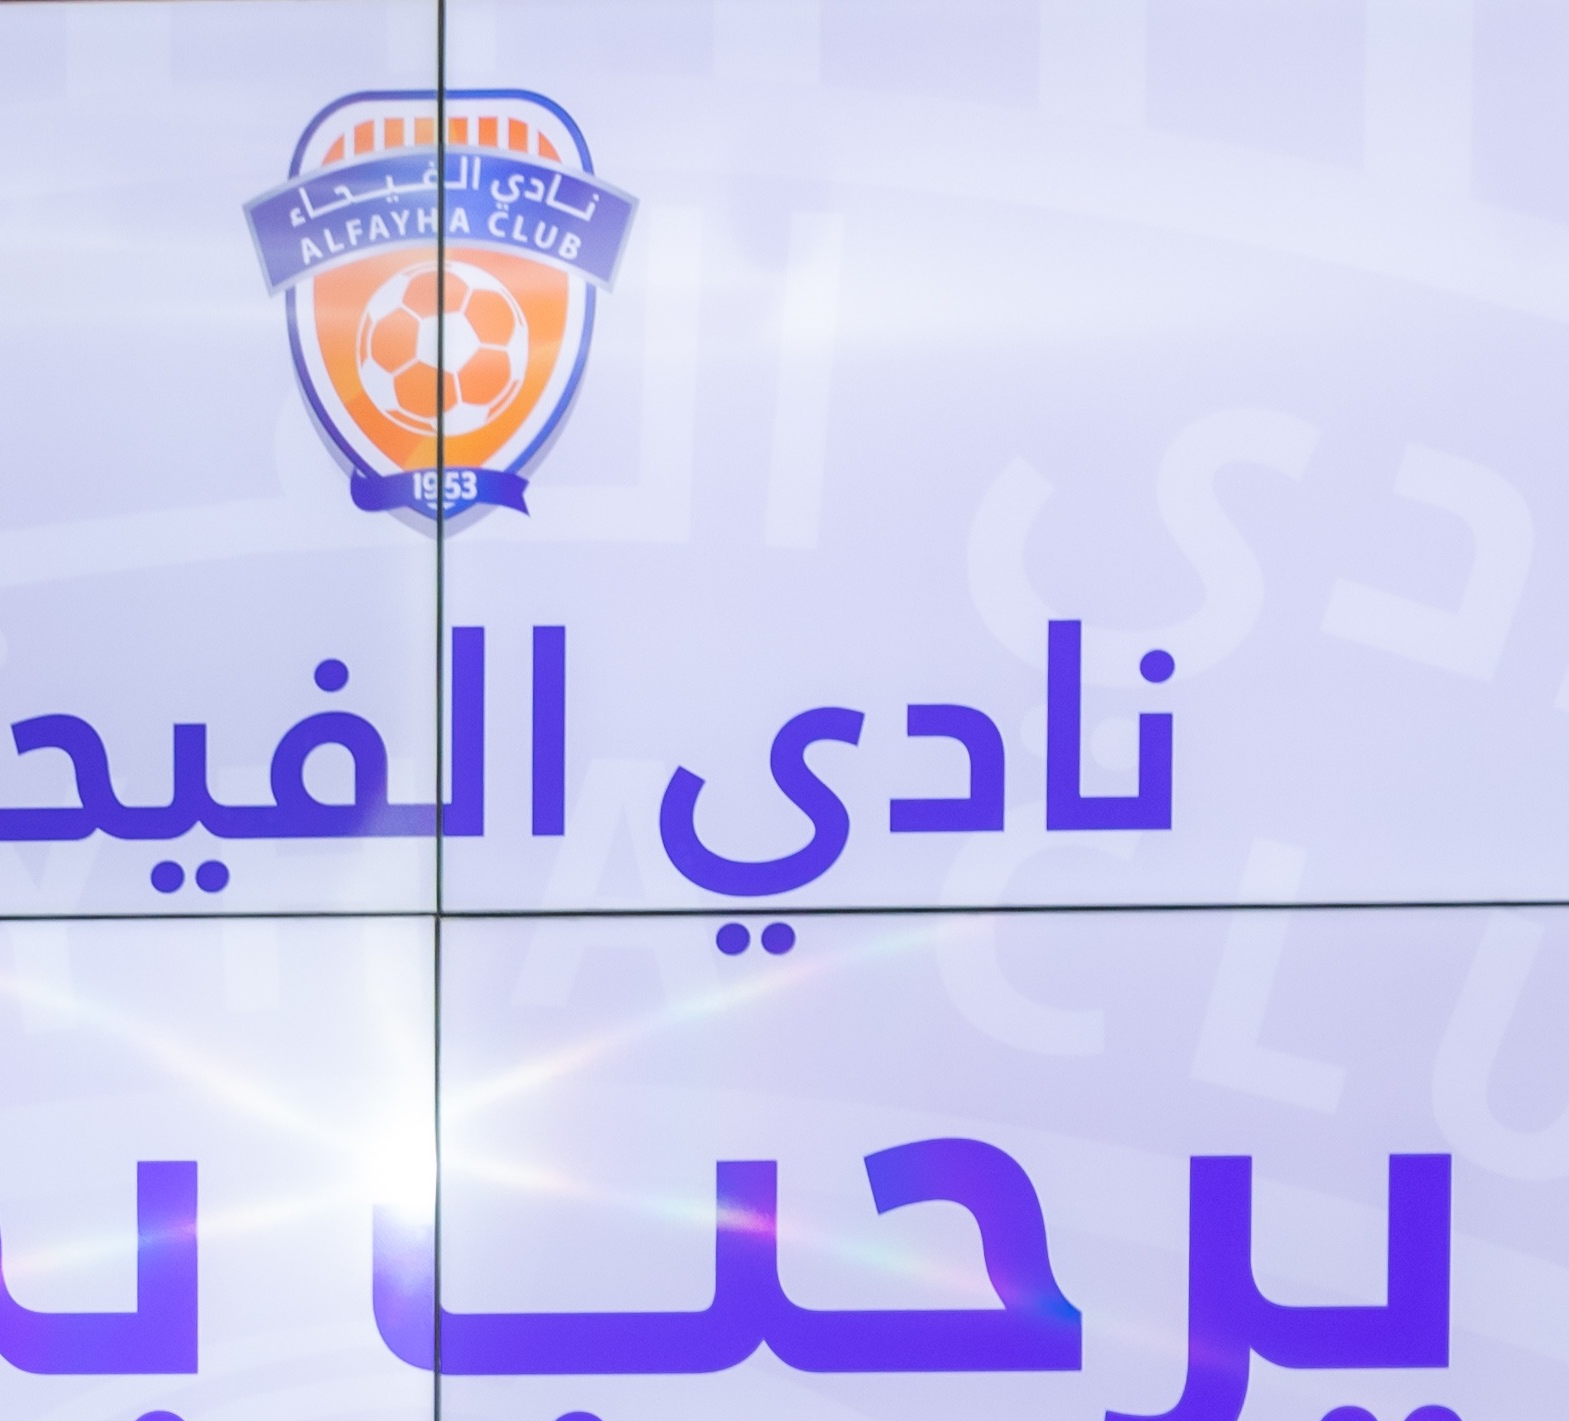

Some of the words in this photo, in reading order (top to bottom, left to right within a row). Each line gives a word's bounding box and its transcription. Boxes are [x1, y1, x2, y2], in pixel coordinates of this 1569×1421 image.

[299, 206, 470, 265] ALFAYHA
[487, 210, 583, 261] CLUB
[413, 471, 478, 500] 1953
[660, 620, 1174, 955] نادي
